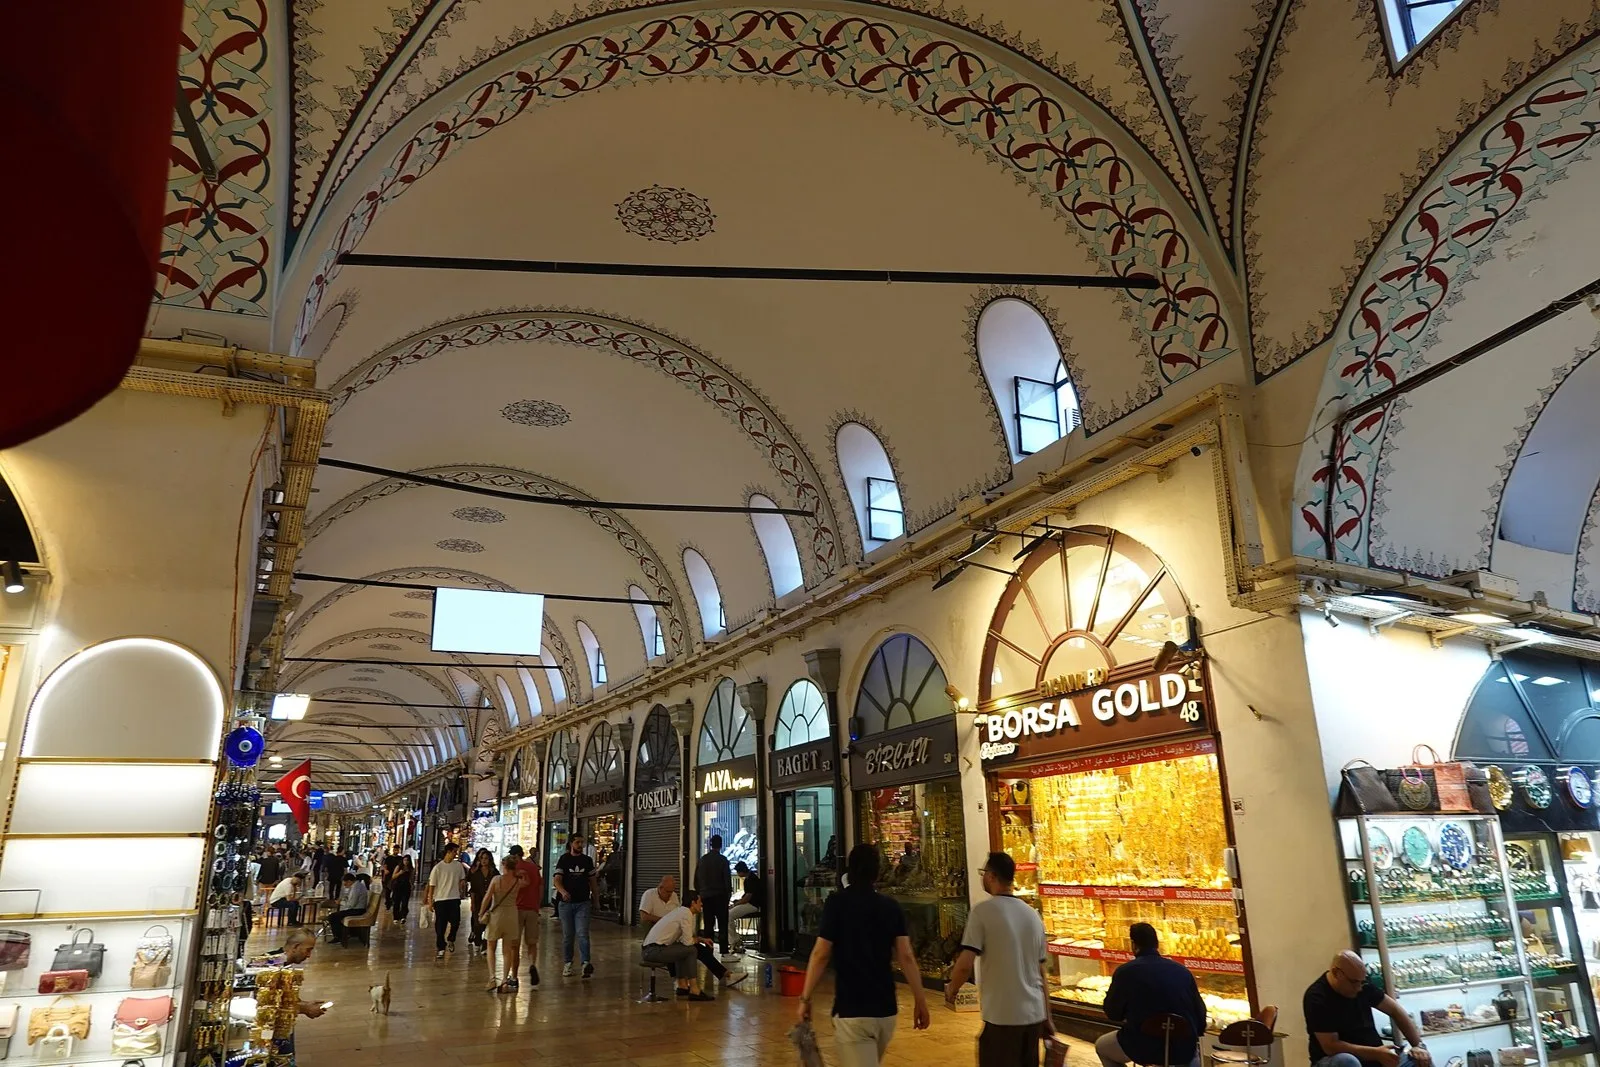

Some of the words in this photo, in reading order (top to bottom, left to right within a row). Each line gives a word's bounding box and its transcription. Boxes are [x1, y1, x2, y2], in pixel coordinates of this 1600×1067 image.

[988, 698, 1082, 742] BORSA
[1092, 673, 1186, 721] GOLD
[1180, 700, 1200, 722] 48
[777, 750, 819, 777] BAGET
[703, 769, 732, 793] ALYA
[1175, 890, 1191, 899] BORSA
[1191, 890, 1205, 899] GOLD
[1184, 959, 1200, 968] BORSA
[1200, 960, 1214, 970] GOLD
